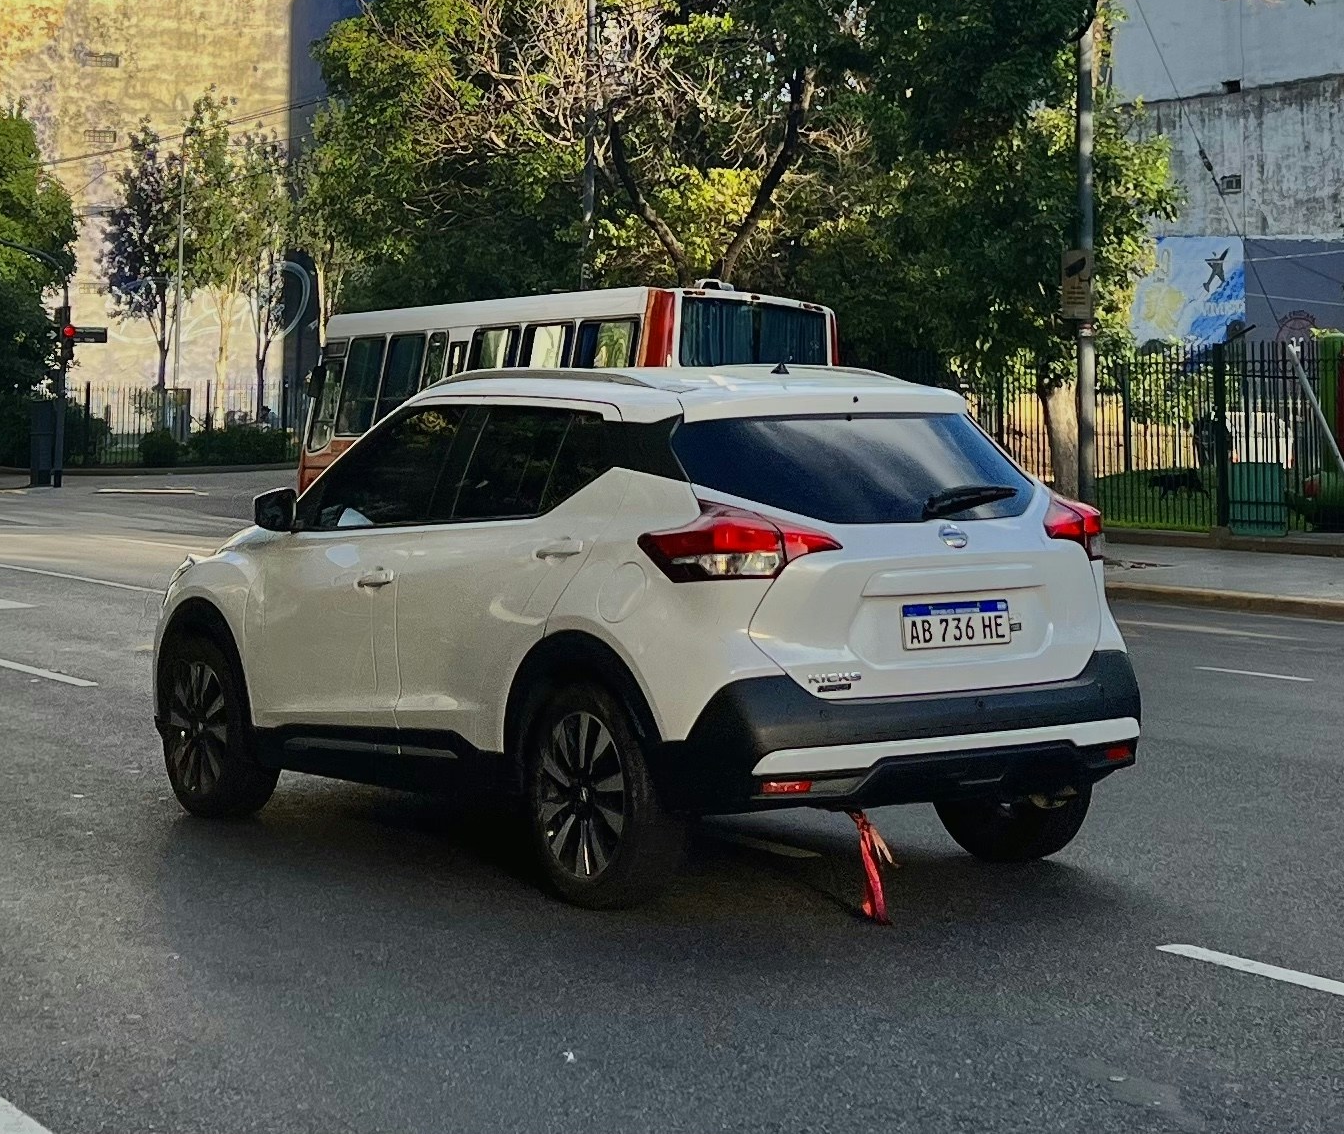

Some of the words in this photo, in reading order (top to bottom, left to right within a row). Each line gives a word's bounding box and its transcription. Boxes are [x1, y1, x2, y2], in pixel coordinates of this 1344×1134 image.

[910, 619, 933, 644] AB
[939, 616, 975, 642] 736
[981, 615, 1006, 639] HE
[807, 671, 862, 684] KICKS
